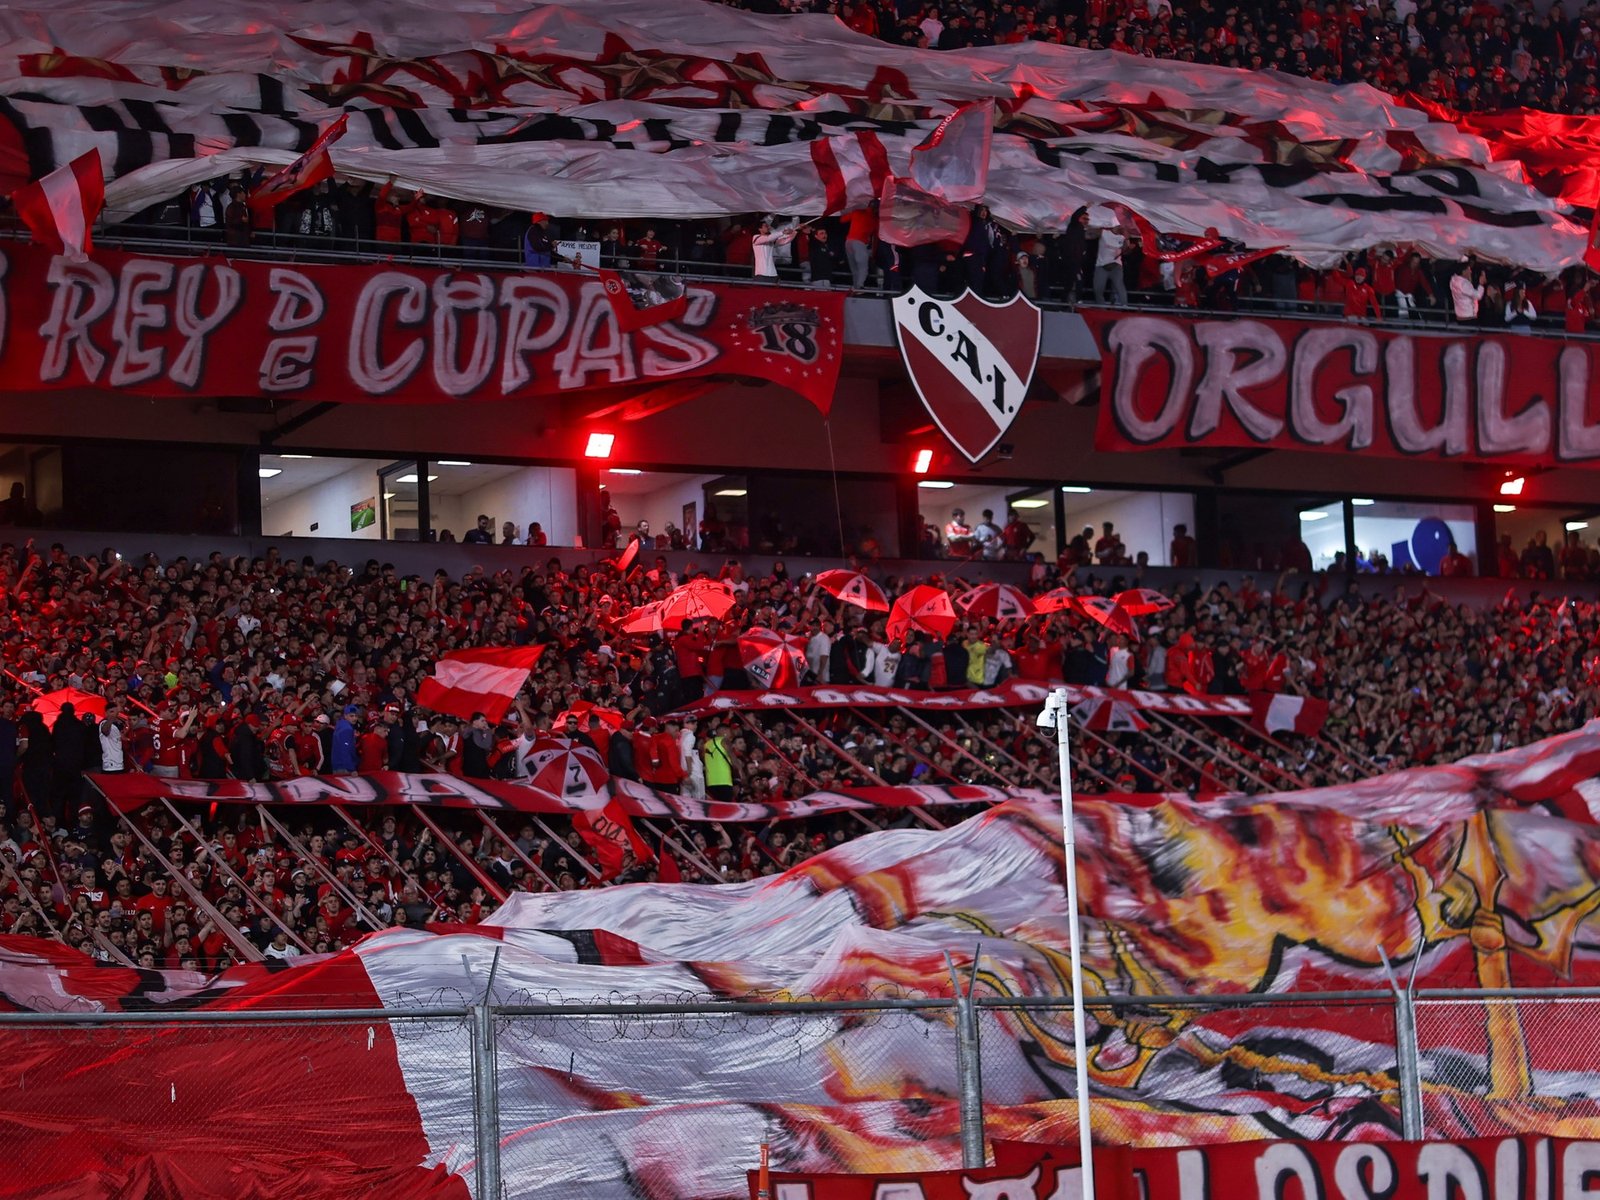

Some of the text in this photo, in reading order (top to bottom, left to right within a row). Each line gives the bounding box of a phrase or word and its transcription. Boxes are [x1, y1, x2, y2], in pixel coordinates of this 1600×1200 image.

[39, 254, 246, 388] REY
[258, 268, 325, 392] DE
[751, 321, 819, 364] 18
[1107, 315, 1600, 460] ORGULL
[160, 770, 506, 809] UNA
